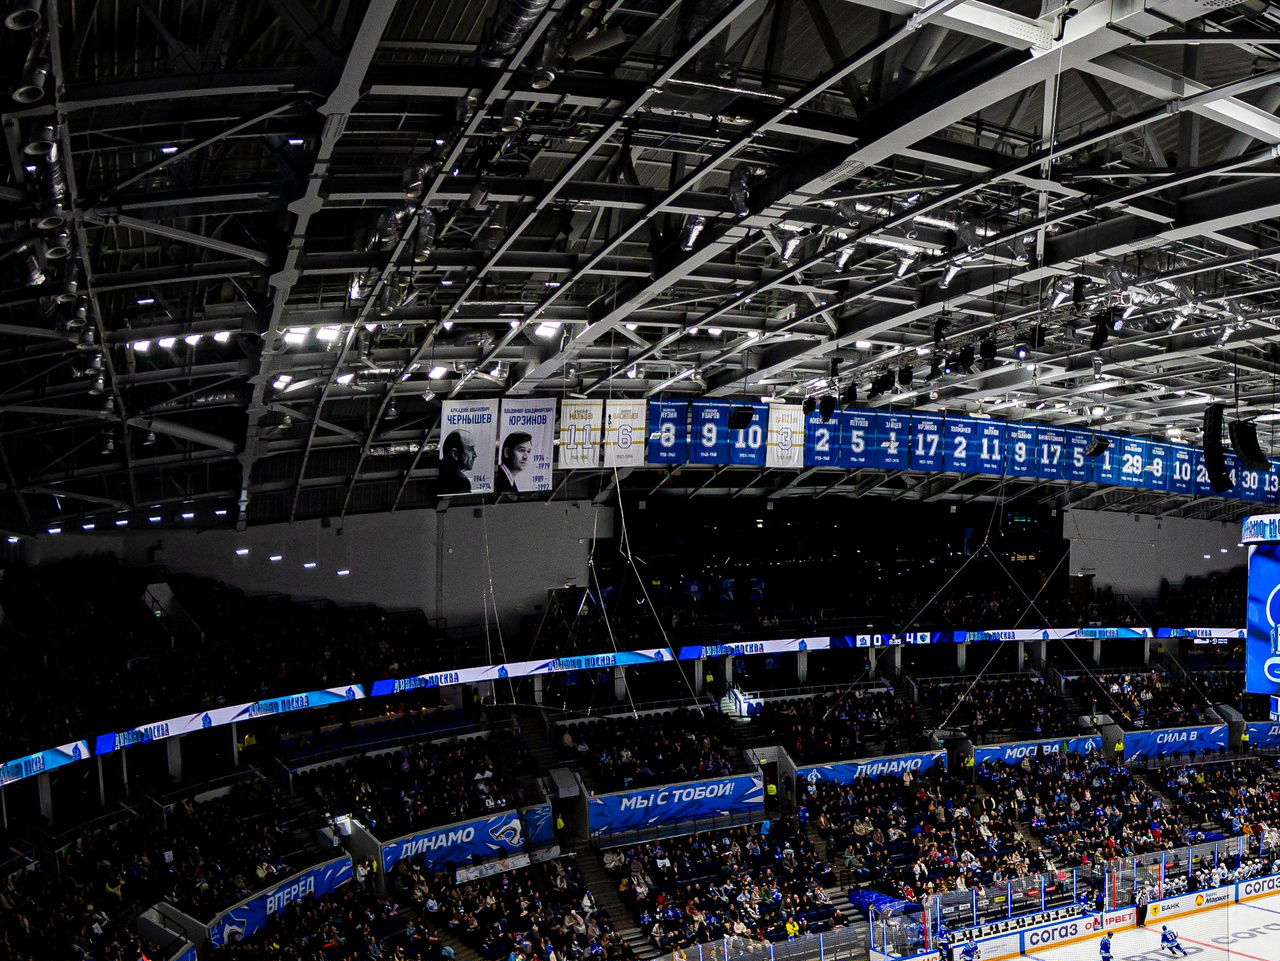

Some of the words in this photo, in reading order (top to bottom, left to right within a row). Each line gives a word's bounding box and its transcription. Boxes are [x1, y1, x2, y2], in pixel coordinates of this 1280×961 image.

[447, 413, 492, 425] ЧЕРНЫШЕВ
[509, 415, 547, 426] ЮРЗИНОВ
[566, 424, 594, 450] 11
[618, 424, 632, 449] 6
[661, 422, 676, 448] 8
[701, 422, 717, 448] 9
[735, 425, 762, 449] 10
[778, 427, 792, 451] 3
[815, 428, 829, 452] 2
[851, 429, 865, 453] 5
[915, 433, 939, 456] 17
[953, 436, 967, 458] 2
[980, 438, 1001, 460] 11
[1014, 442, 1027, 463] 9
[1040, 443, 1062, 465] 17
[1073, 447, 1084, 468] 5
[1102, 451, 1111, 471] 1
[1173, 461, 1191, 481] 10
[1241, 471, 1258, 490] 30
[1264, 474, 1279, 492] 13
[734, 643, 764, 654] МОСКВА
[874, 635, 881, 645] 0
[906, 633, 913, 643] 4
[585, 655, 616, 668] МОСКВА
[429, 672, 459, 687] МОСКВА
[281, 694, 309, 712] МОСКВА
[143, 723, 169, 742] МОСКВА
[1156, 731, 1186, 745] СИЛА
[1187, 731, 1198, 743] В
[853, 758, 922, 779] ДИНАМО
[620, 794, 654, 811] МЫ
[657, 791, 669, 806] С
[671, 782, 734, 804] ТОБОЙ!
[399, 827, 475, 860] ДИНАМО
[266, 875, 315, 915] ВПЕРЁД
[1161, 902, 1180, 912] БАНК
[1029, 922, 1079, 946] согаз
